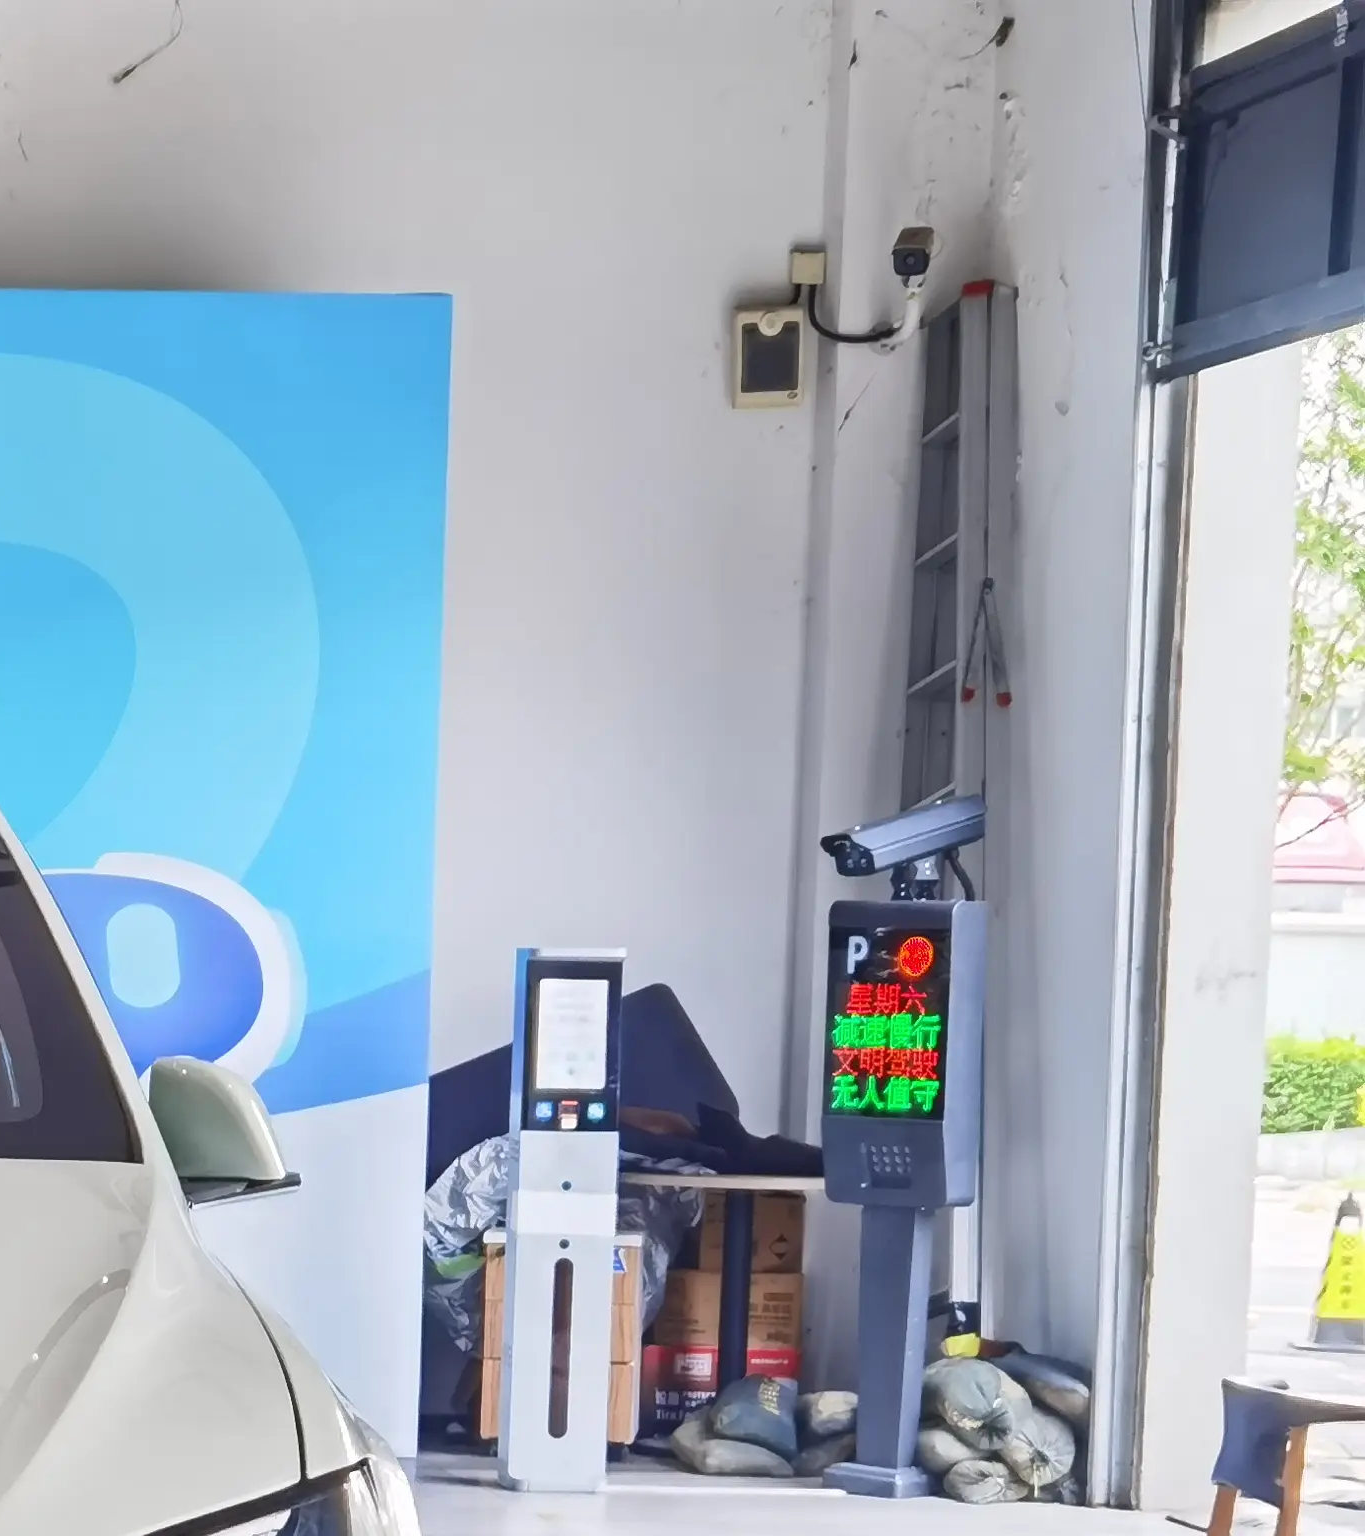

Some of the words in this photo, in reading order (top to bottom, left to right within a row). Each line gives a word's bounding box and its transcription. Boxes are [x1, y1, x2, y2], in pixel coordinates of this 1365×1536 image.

[846, 935, 869, 975] P
[846, 983, 928, 1015] 星期六
[831, 1013, 941, 1050] 减速慢行
[831, 1046, 940, 1080] 文明驾驶
[831, 1073, 940, 1114] 无人值守
